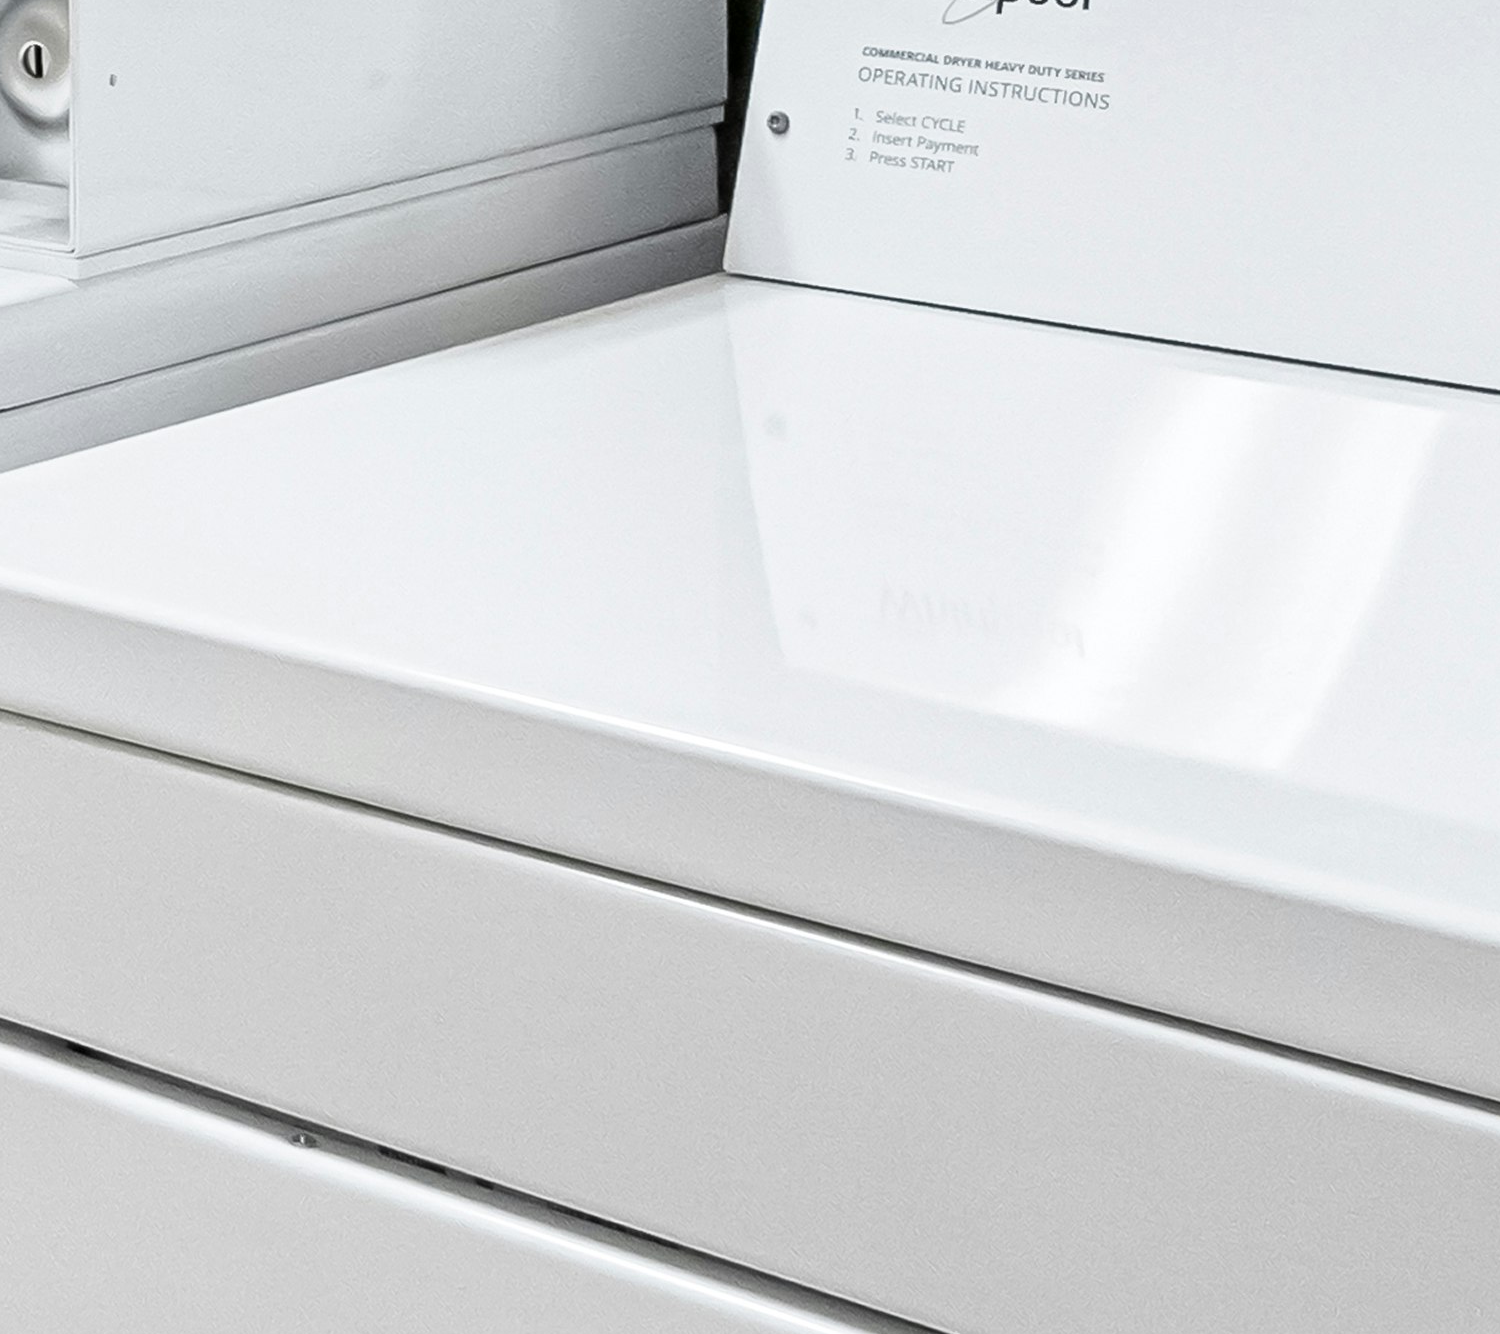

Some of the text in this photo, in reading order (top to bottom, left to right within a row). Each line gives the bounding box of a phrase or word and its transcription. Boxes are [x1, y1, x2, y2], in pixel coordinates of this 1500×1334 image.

[862, 46, 1105, 83] COMMERCIAL DRYER HEAVY DUTY SERIES
[858, 66, 1111, 110] OPERATING INSTRUCTIONS
[876, 110, 917, 128] Select
[921, 116, 966, 134] CYCLE
[873, 130, 912, 148] Insert
[917, 135, 979, 157] Payment
[869, 151, 907, 168] Press
[911, 156, 955, 173] START
